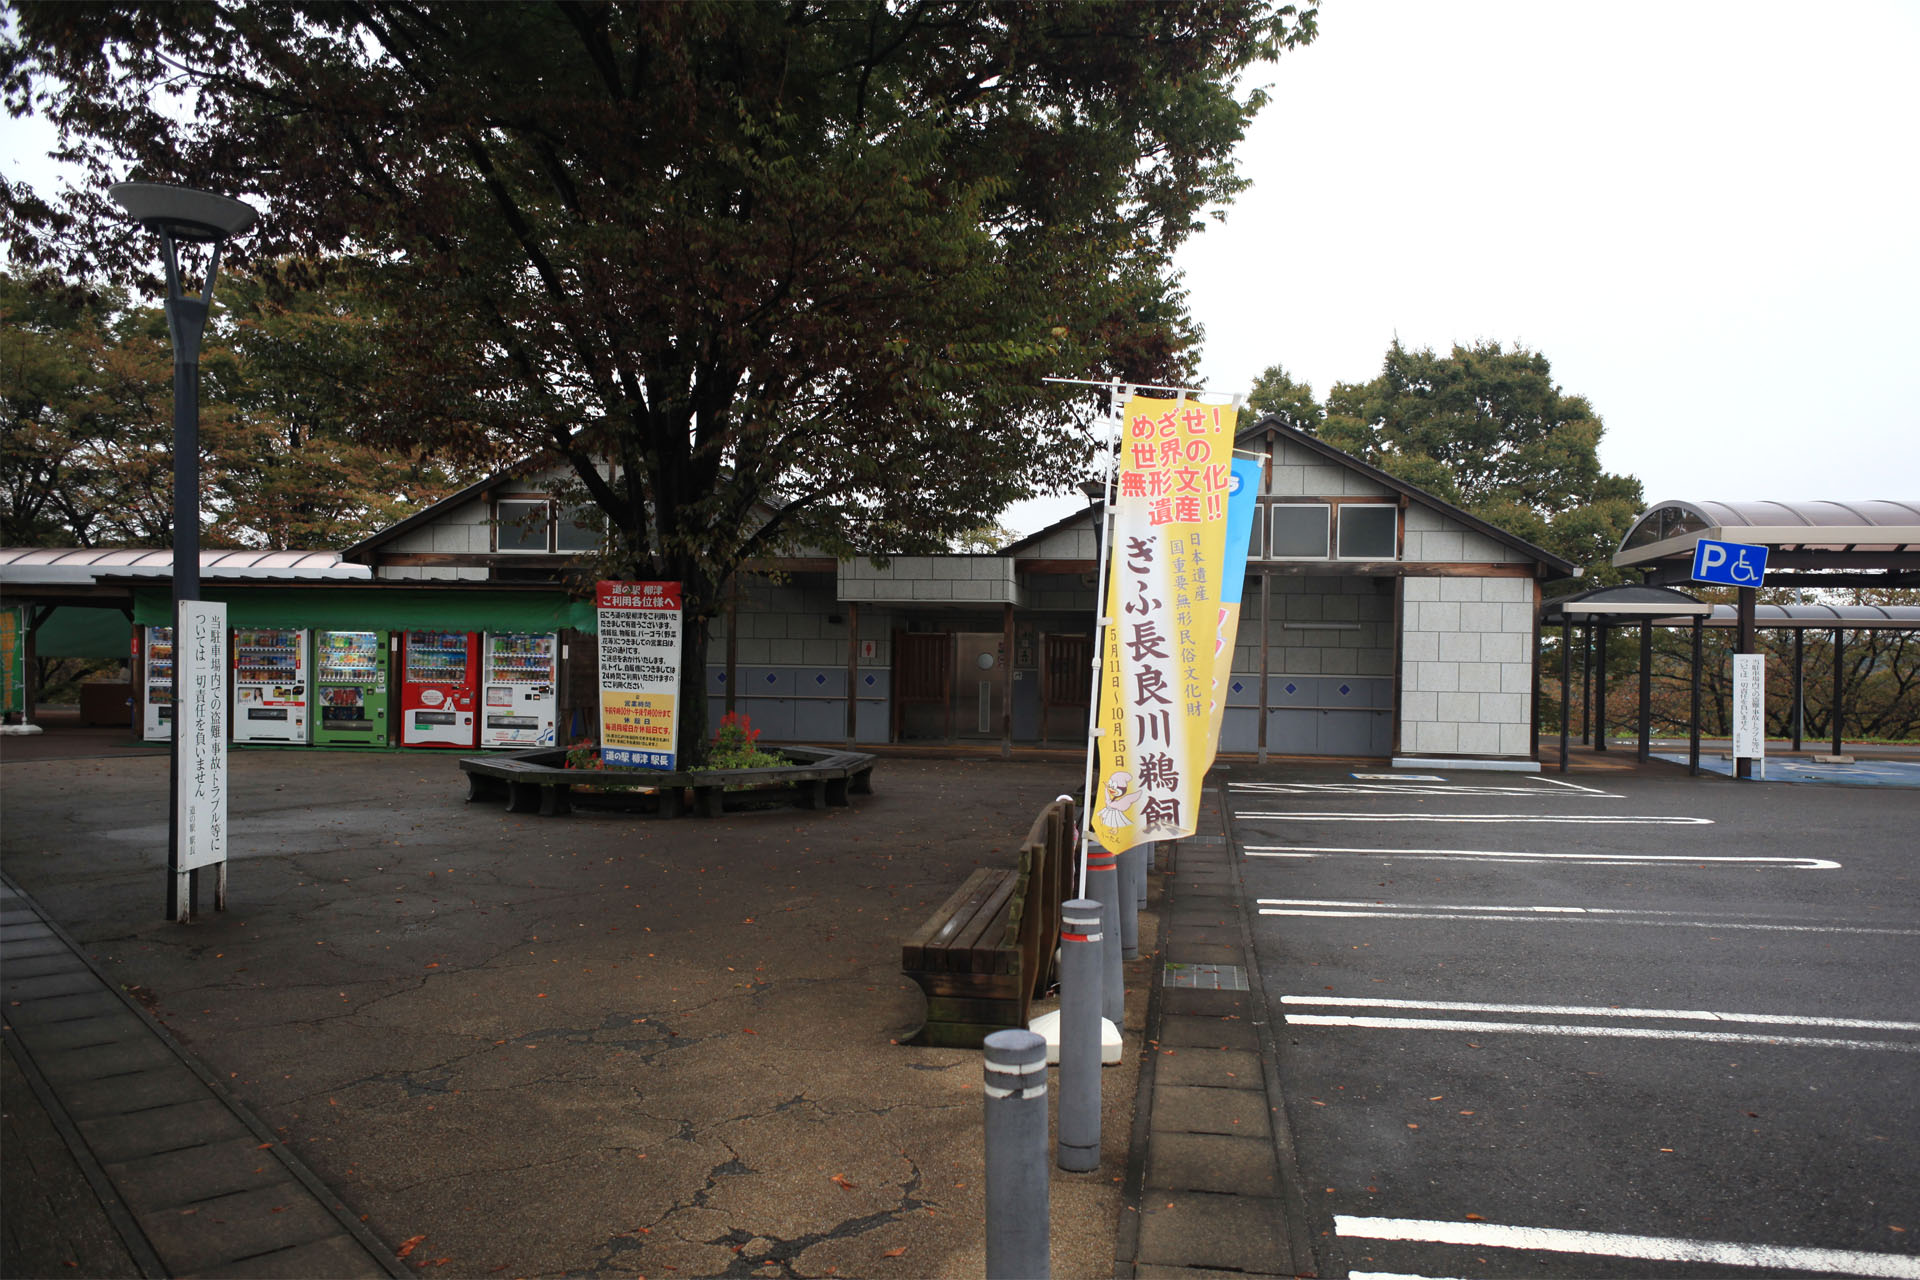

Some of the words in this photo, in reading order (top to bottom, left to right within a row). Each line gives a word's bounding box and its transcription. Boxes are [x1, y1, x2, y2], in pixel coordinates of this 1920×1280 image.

[1131, 407, 1222, 440] めざせ！
[1130, 437, 1211, 470] 世界の
[1121, 463, 1229, 498] 無形文化
[1147, 494, 1223, 527] 遺産！！
[1190, 532, 1209, 601] 日本遺産
[1700, 544, 1727, 577] P
[602, 595, 675, 608] ご利用各位様へ
[612, 584, 640, 595] 道の駅
[1170, 539, 1202, 717] 国重要無形民俗文化財
[1125, 536, 1180, 835] ぎふ長良川鵜飼
[606, 750, 630, 763] 道の駅
[650, 754, 669, 766] 駅長
